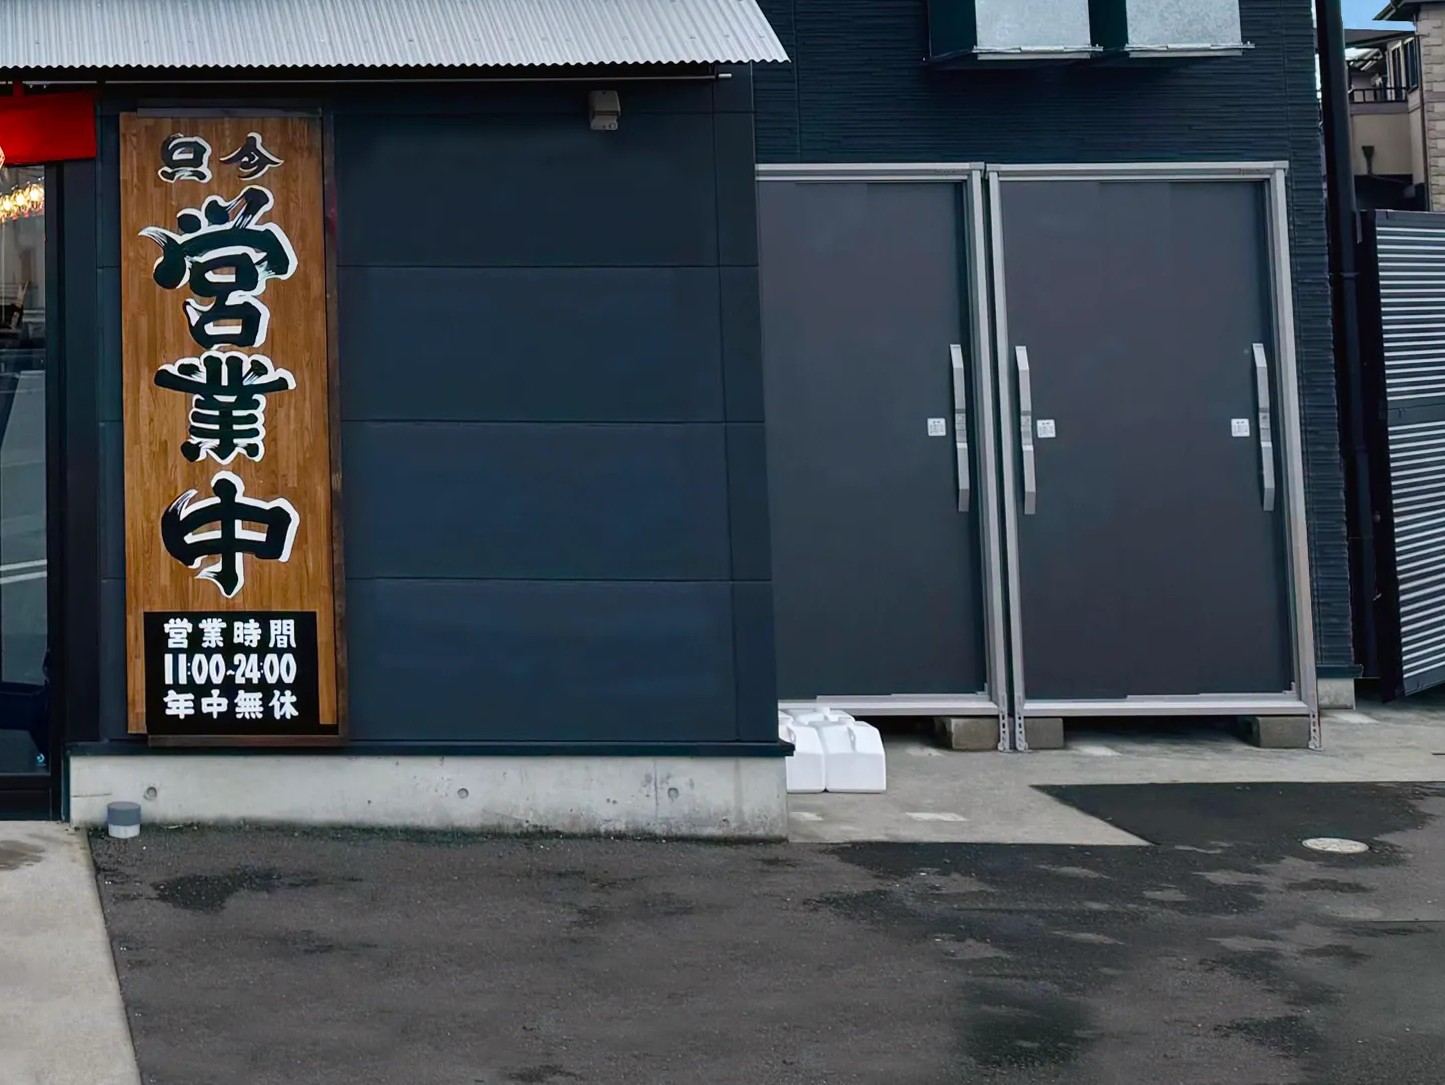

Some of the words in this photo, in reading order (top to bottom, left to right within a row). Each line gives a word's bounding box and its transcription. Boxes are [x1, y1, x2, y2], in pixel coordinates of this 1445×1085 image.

[138, 185, 301, 599] 営業中
[163, 618, 297, 648] 営業時間
[163, 689, 299, 720] 年中無休
